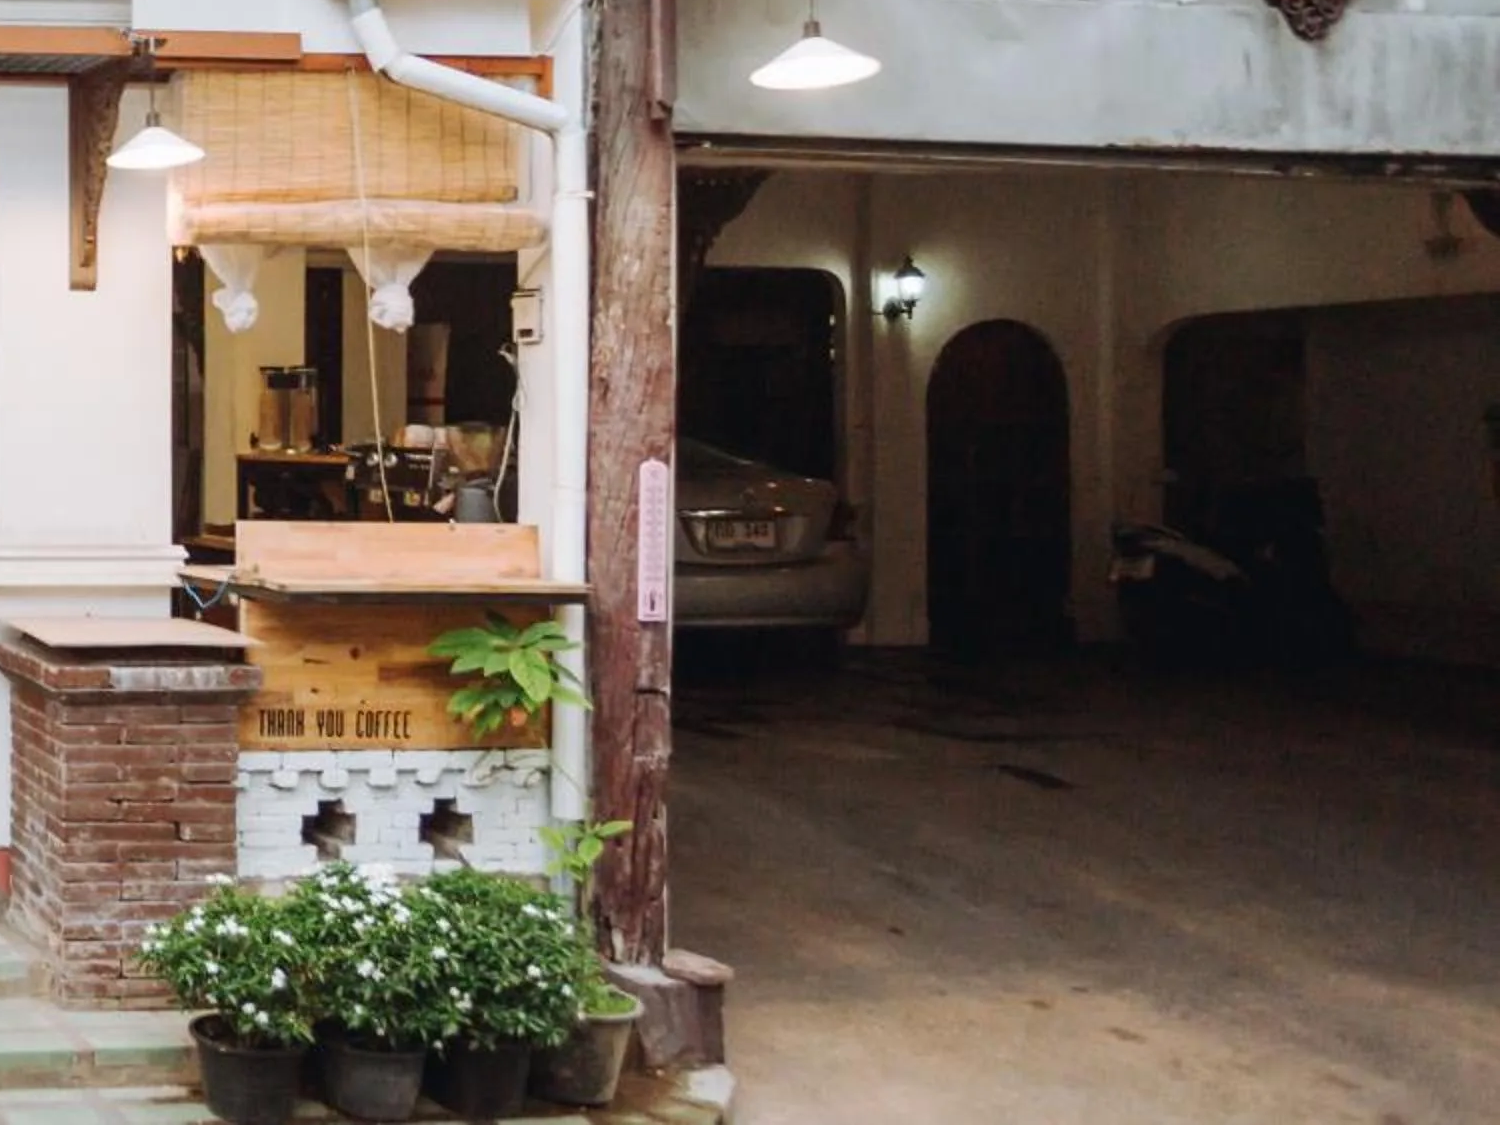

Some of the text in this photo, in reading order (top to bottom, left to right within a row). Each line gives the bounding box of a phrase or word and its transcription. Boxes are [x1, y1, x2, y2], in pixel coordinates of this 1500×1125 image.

[258, 708, 412, 740] THANK YOU COFFEE
